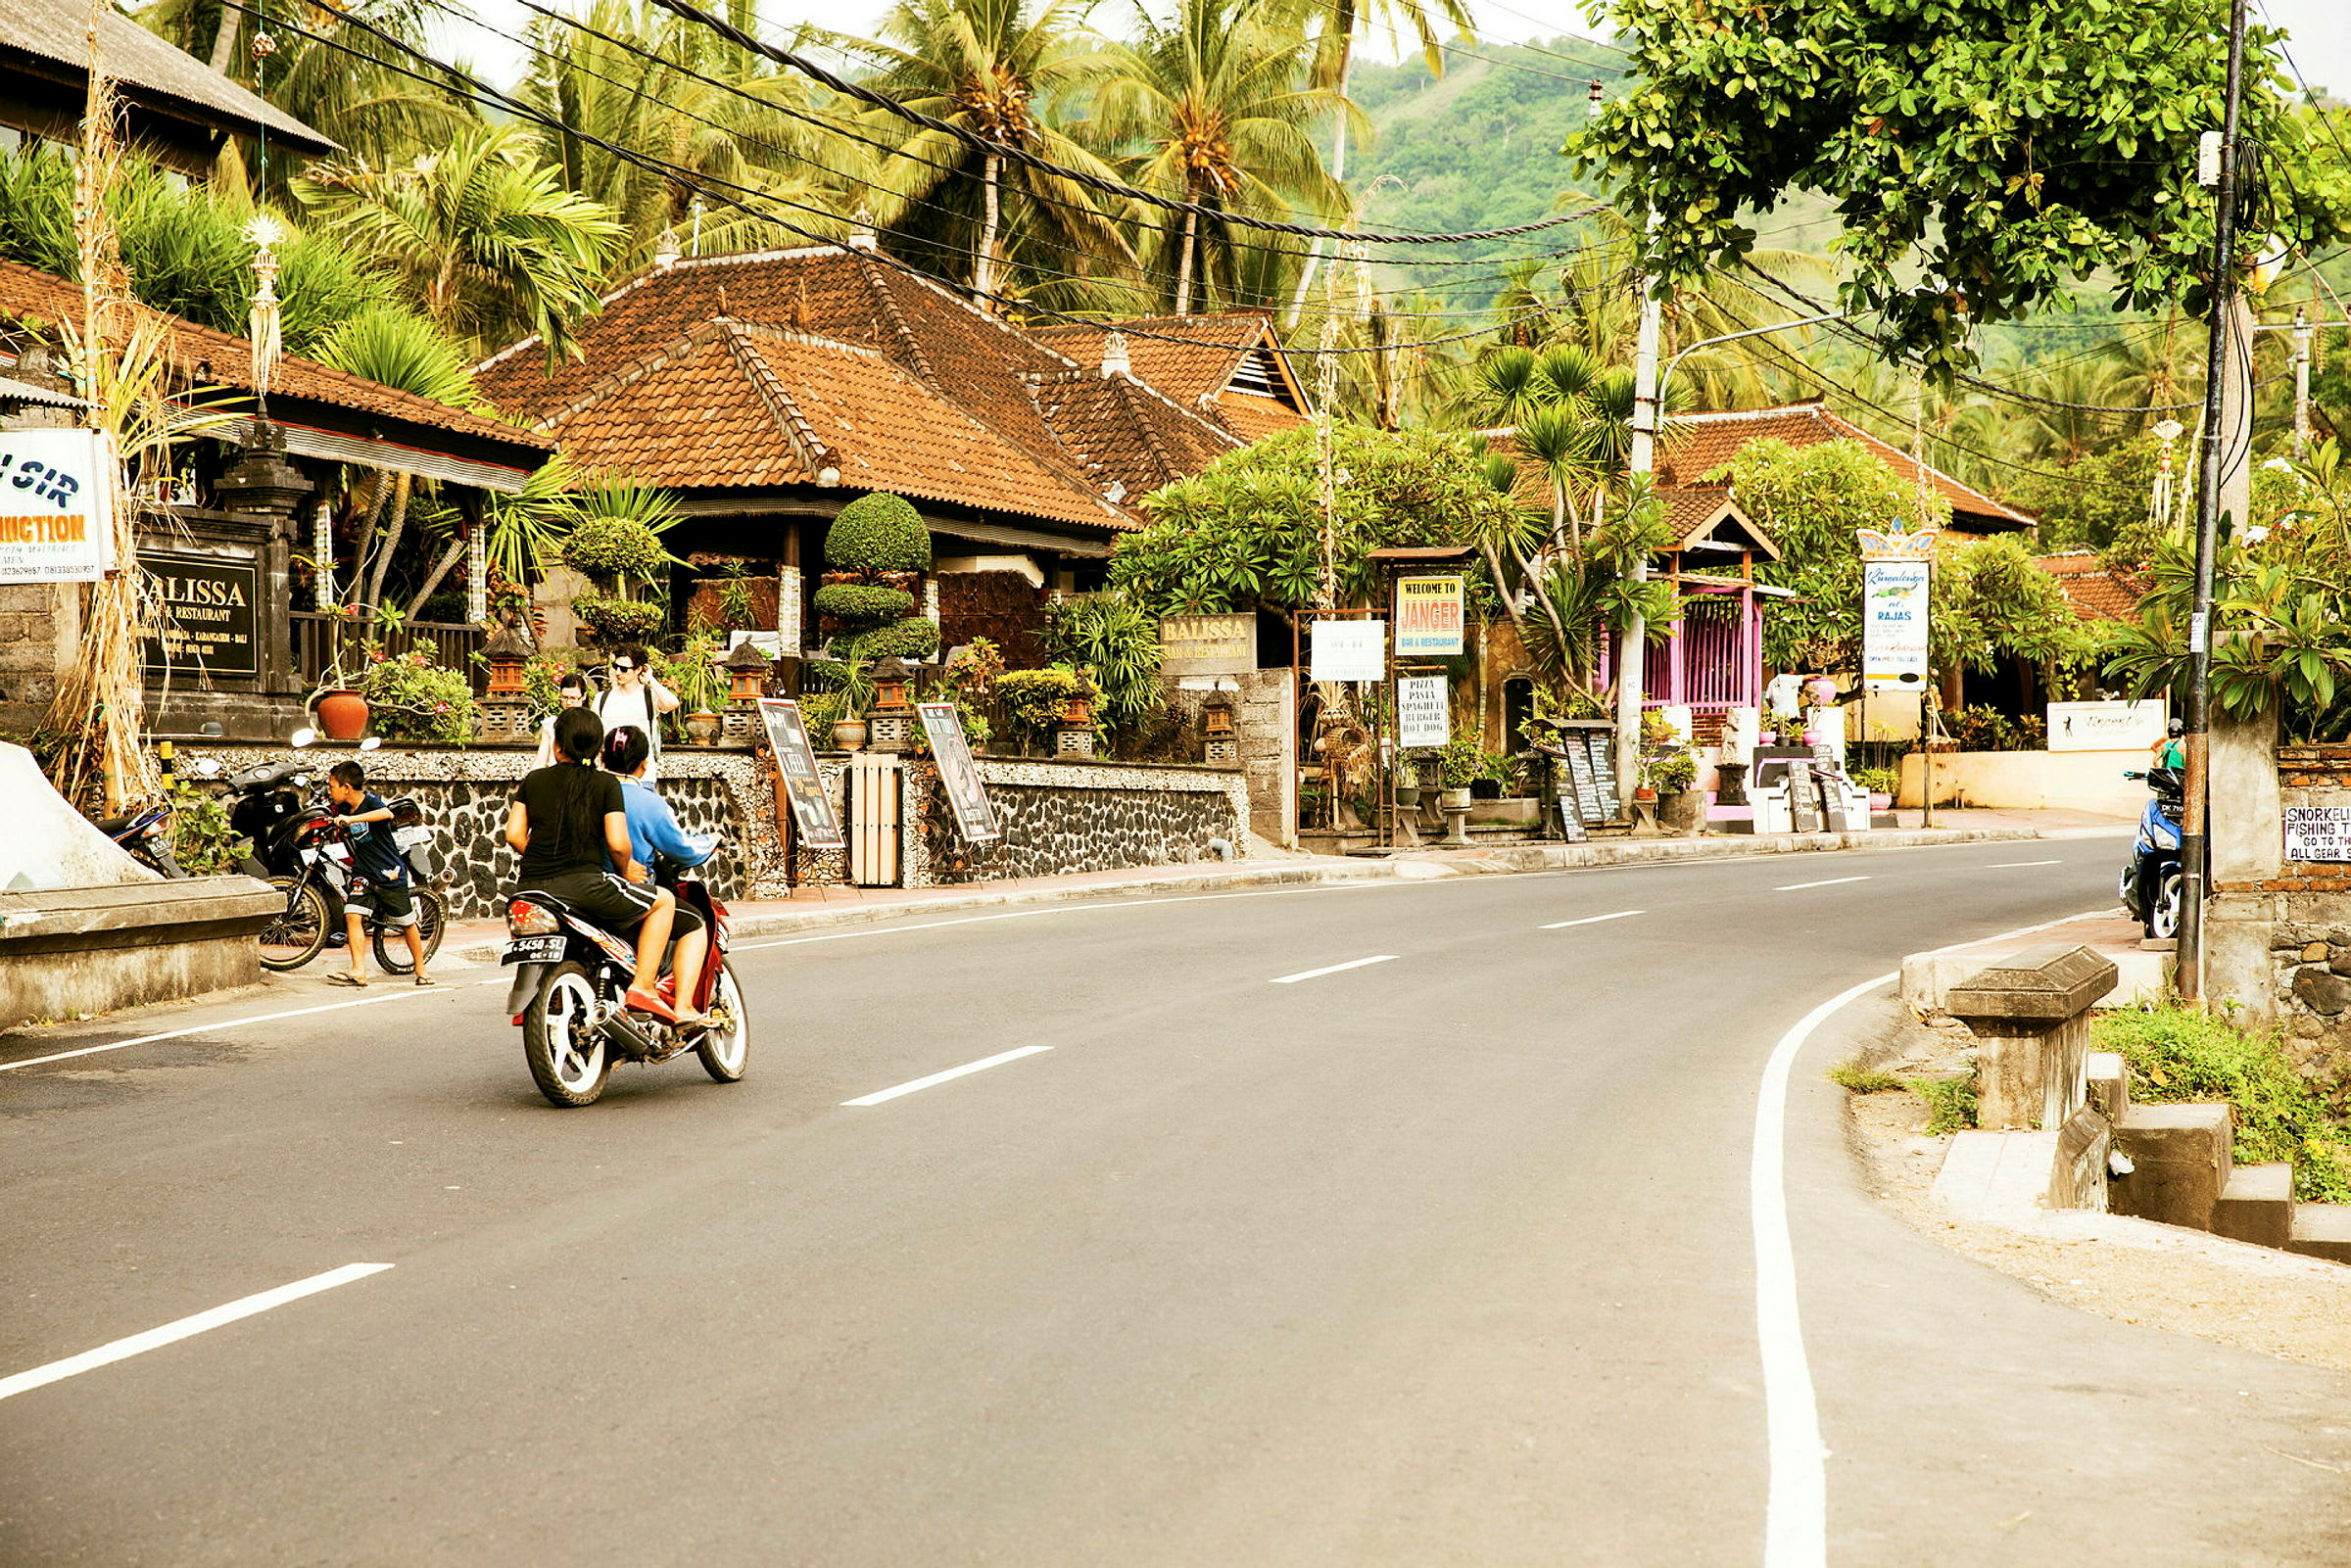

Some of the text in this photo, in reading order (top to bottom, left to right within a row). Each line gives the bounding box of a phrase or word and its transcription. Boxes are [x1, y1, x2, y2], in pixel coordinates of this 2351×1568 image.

[12, 461, 79, 508] SIR
[1405, 583, 1456, 594] WELCOME TO
[175, 606, 231, 622] RESTAURANT
[1401, 601, 1460, 630] JANGER
[1878, 611, 1912, 621] RAJAS
[1163, 620, 1247, 641] BALISSA
[1410, 680, 1434, 689] PIZZA
[1409, 690, 1435, 699] PASTA
[2287, 823, 2335, 835] FISHING
[2303, 837, 2318, 847] GO
[2291, 848, 2311, 859] ALL
[2315, 848, 2340, 859] GEAR
